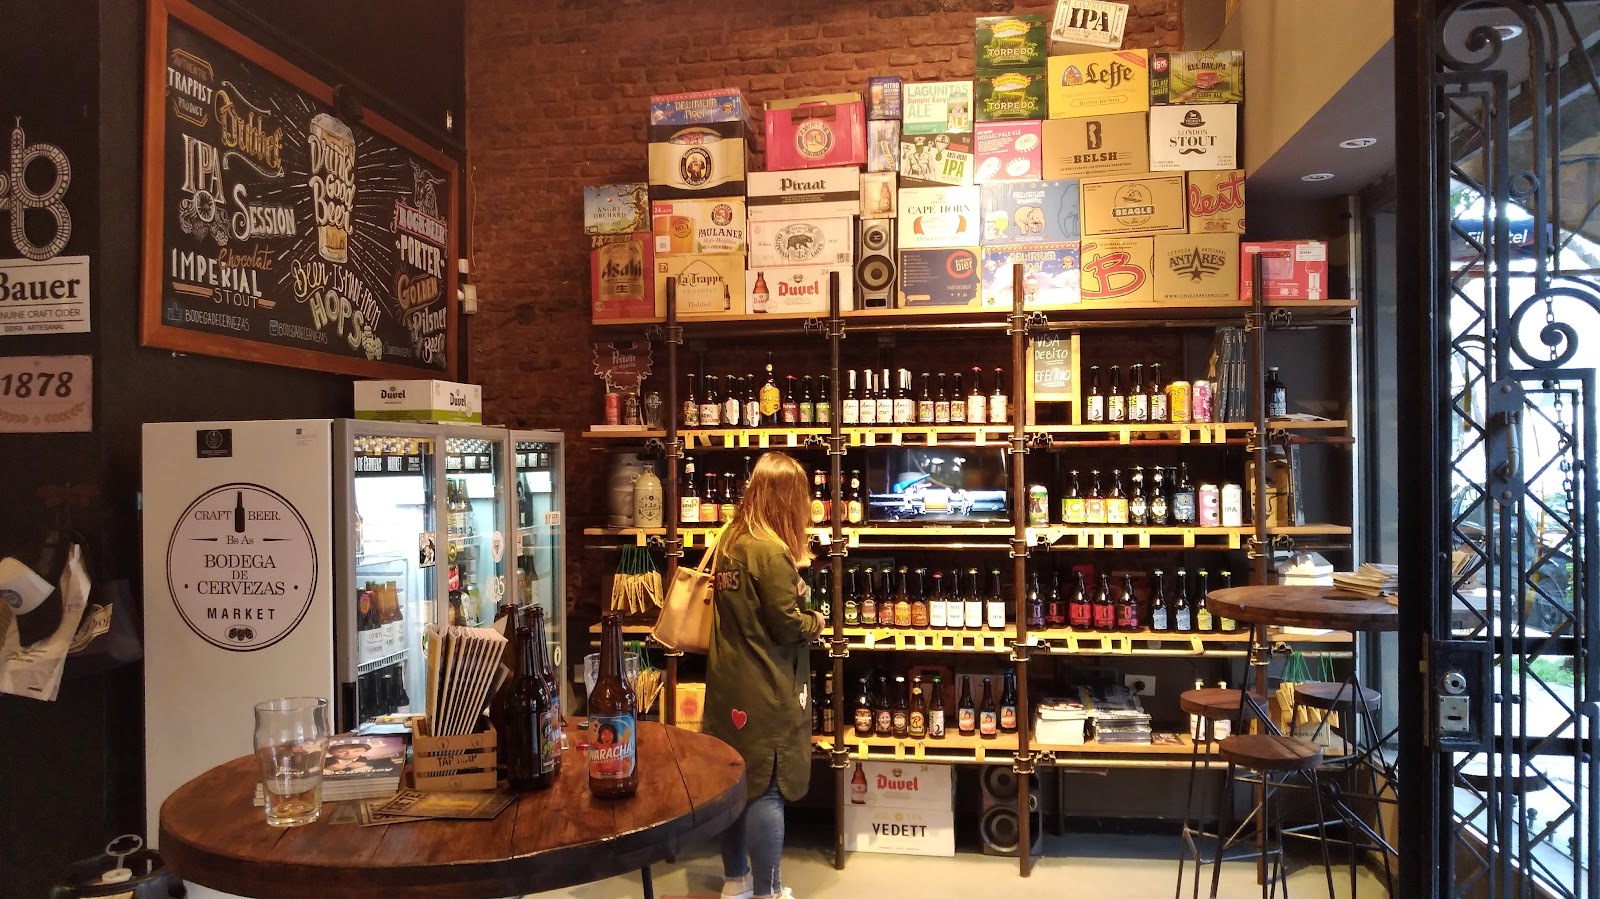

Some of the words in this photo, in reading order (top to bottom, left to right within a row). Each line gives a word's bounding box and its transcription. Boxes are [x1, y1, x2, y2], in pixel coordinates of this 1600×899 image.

[1068, 8, 1109, 33] IPA
[988, 48, 1034, 57] TORPEDO
[1201, 62, 1214, 70] DAY
[1215, 63, 1226, 71] IPA
[1084, 61, 1135, 89] Leffe
[167, 66, 213, 105] TRAPPIST
[883, 82, 900, 90] NITRO
[907, 85, 969, 98] LAGUNITAS
[674, 98, 718, 111] DELIRIUM
[932, 96, 947, 104] Easy
[988, 101, 1034, 111] TORPEDO
[908, 103, 932, 119] ALE
[947, 114, 969, 129] ALE
[977, 132, 998, 141] MOSAIC
[998, 131, 1011, 139] PALE
[1169, 136, 1218, 148] STOUT
[308, 134, 355, 188] Drink
[1073, 152, 1118, 164] BELSH
[182, 132, 226, 205] IPA
[943, 159, 965, 179] IPA
[779, 177, 826, 192] Piraat
[325, 173, 356, 213] Good
[309, 175, 354, 235] Beer
[907, 206, 937, 215] CAPE
[940, 204, 971, 214] HORN
[1115, 206, 1152, 217] BEAGLE
[593, 212, 627, 220] ORCHARD
[698, 228, 743, 240] PAULANER
[216, 244, 275, 272] Chocolate
[399, 233, 442, 280] PORTER
[1009, 250, 1057, 262] DELIRIUM
[1169, 247, 1226, 269] ANTARES
[171, 247, 262, 298] IMPERIAL
[602, 259, 643, 279] Asahi
[688, 273, 724, 287] Trappe
[778, 280, 820, 297] Duvel
[212, 287, 259, 310] STOUT
[0, 310, 26, 320] NUINE
[27, 308, 54, 319] CRAFT
[55, 308, 81, 317] CIDER
[309, 289, 364, 351] HOPS
[27, 323, 64, 331] ARTESANAL
[1036, 334, 1061, 348] VISA
[2, 371, 74, 399] 1878
[380, 389, 406, 400] Duvel
[449, 392, 467, 407] Duvel
[194, 510, 232, 521] CRAFT
[1223, 506, 1238, 514] IPA
[226, 535, 240, 545] Bs
[241, 535, 255, 545] As
[204, 554, 277, 569] BODEGA
[232, 570, 249, 580] DE
[197, 581, 286, 596] CERVEZAS
[207, 607, 276, 620] MARKET
[437, 755, 454, 767] TAP
[876, 773, 919, 791] Duvel
[872, 822, 927, 838] VEDETT
